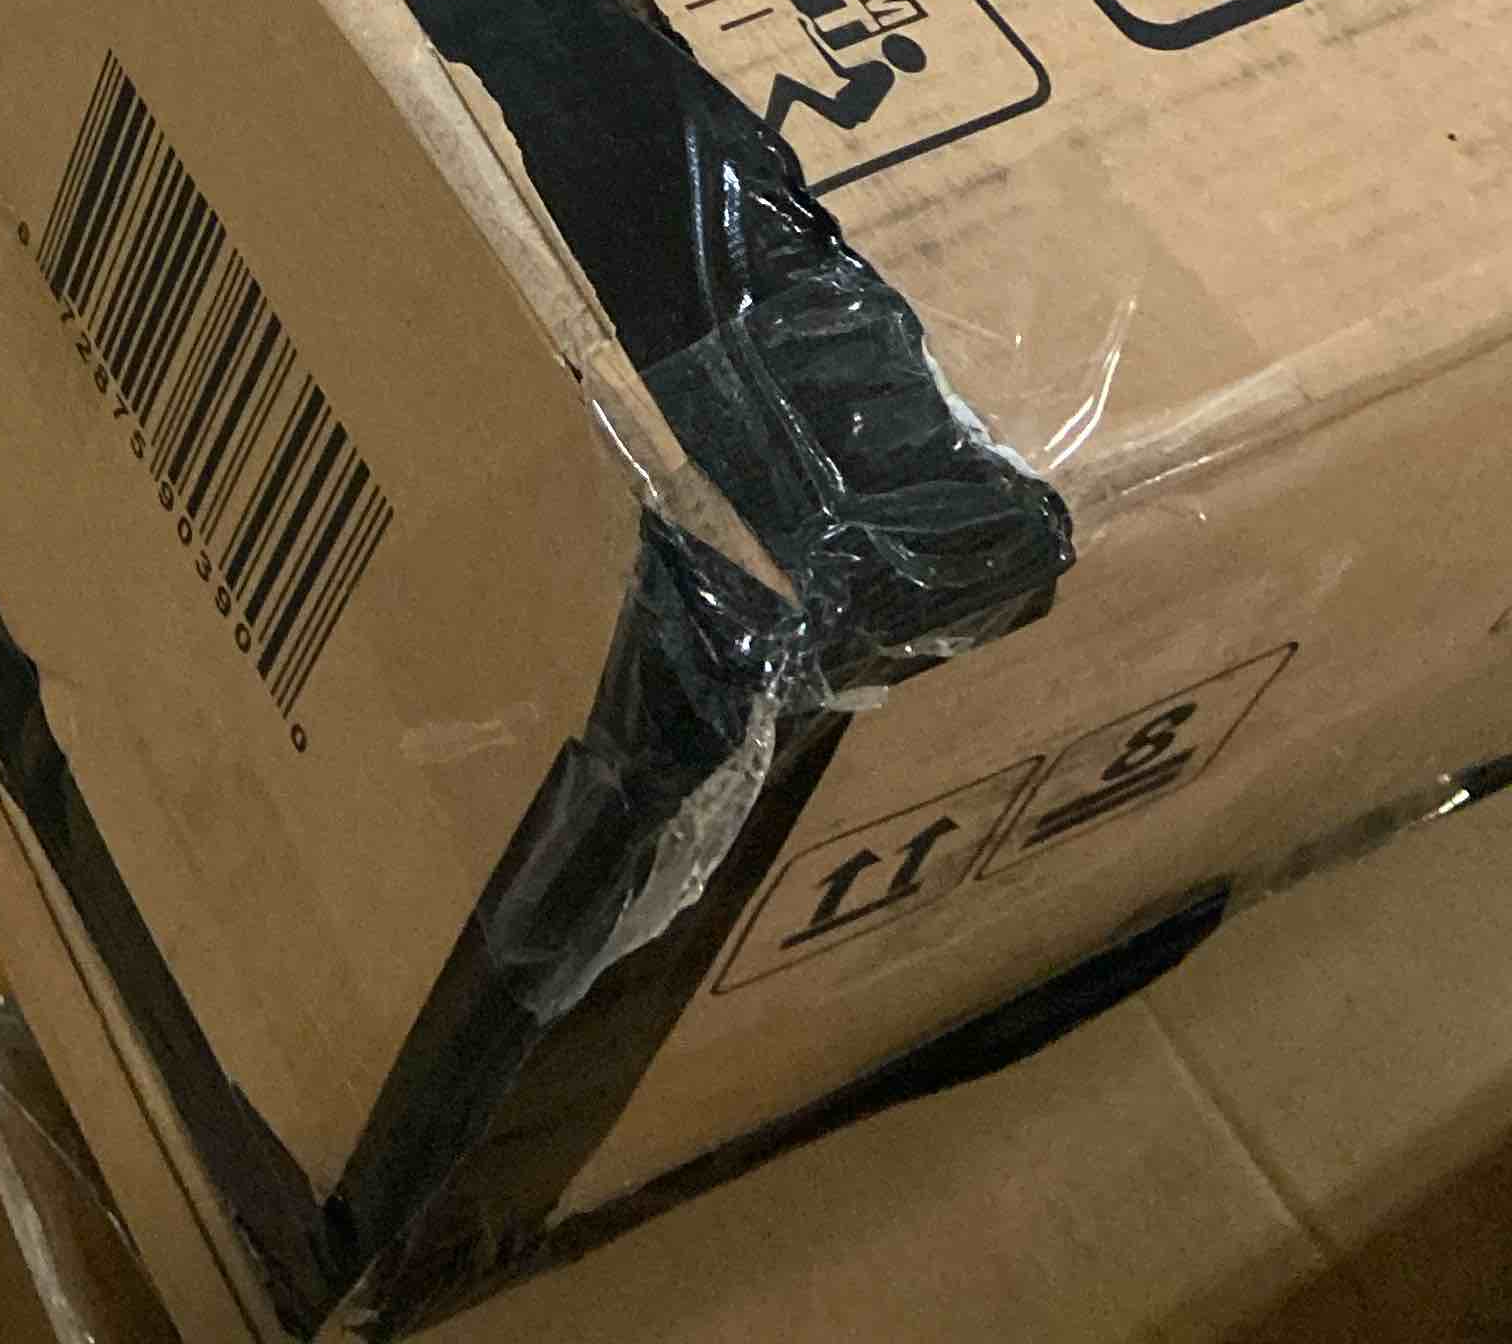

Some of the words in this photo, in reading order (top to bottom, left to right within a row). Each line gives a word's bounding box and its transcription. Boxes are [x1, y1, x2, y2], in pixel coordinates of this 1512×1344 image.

[59, 306, 149, 461] 72875
[156, 480, 252, 654] 90390
[290, 722, 309, 755] 0
